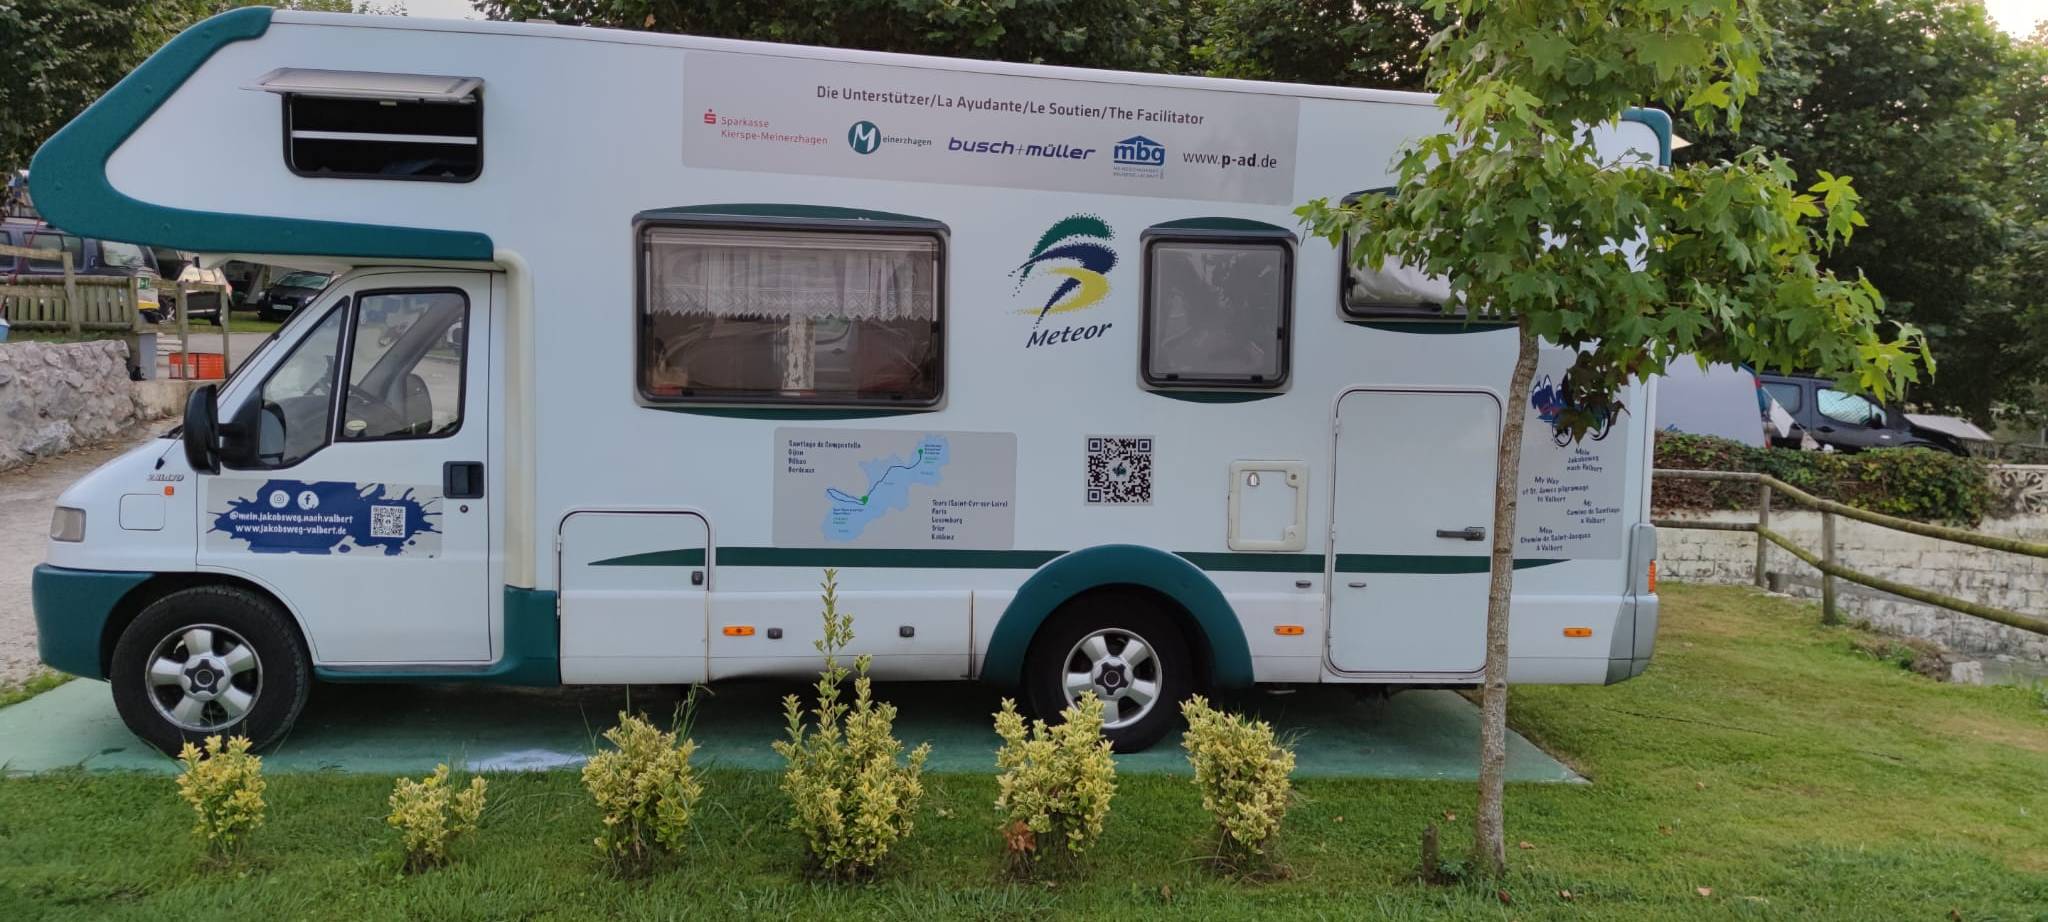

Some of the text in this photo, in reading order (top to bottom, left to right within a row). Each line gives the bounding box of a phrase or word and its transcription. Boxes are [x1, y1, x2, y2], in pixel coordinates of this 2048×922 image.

[817, 86, 1204, 125] Die Unterstützer/La Ayudante/Le Soutien/The Facilitator
[721, 117, 769, 128] Sparkasse
[721, 130, 828, 145] Kierspe-Meinerzhagen
[1114, 140, 1165, 166] mbg
[1183, 152, 1277, 168] www.p-ad.de
[1026, 323, 1113, 348] Meteor
[229, 511, 353, 524] @mein.jakobsweg.nach.valbert
[235, 524, 347, 535] www.jakobsweg-valbert.de
